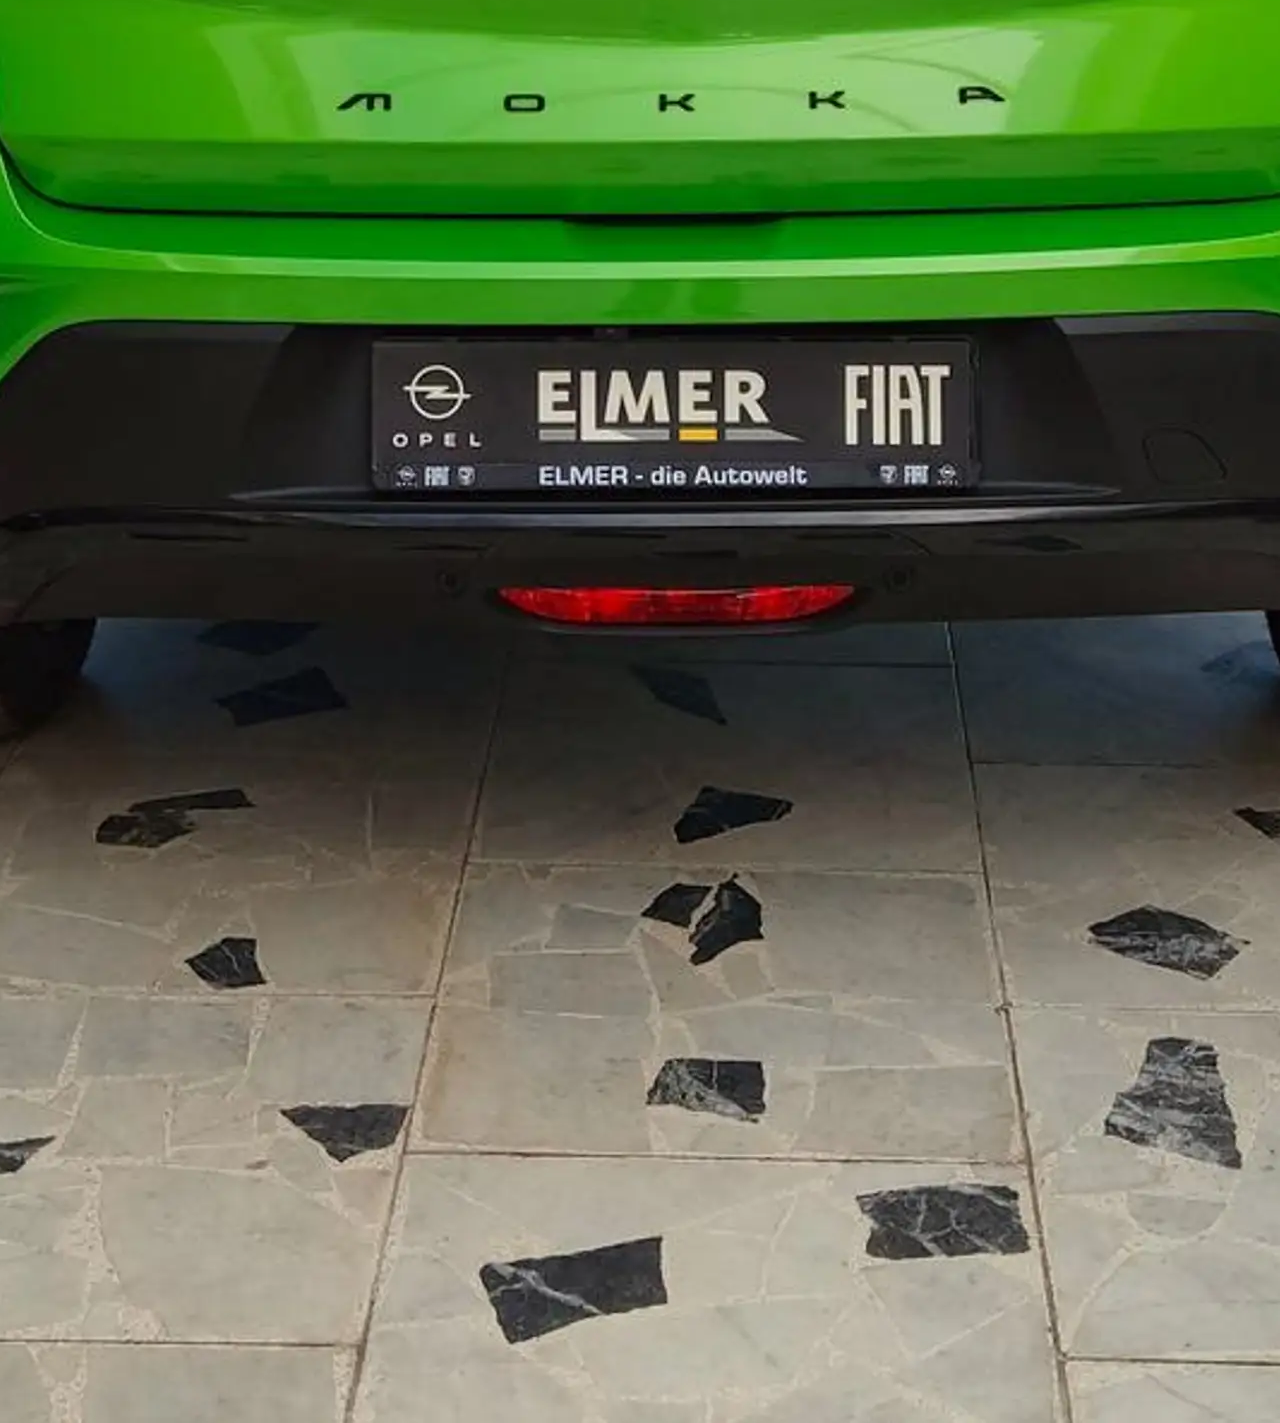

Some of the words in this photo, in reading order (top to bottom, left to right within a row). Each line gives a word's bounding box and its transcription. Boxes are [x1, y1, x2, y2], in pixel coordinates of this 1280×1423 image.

[337, 85, 1007, 115] MOKKA
[537, 369, 771, 443] ELMER
[843, 364, 951, 446] FIAT
[392, 432, 482, 449] OPEL
[538, 465, 629, 486] ELMER
[650, 465, 687, 486] die
[694, 465, 808, 486] Autowelt
